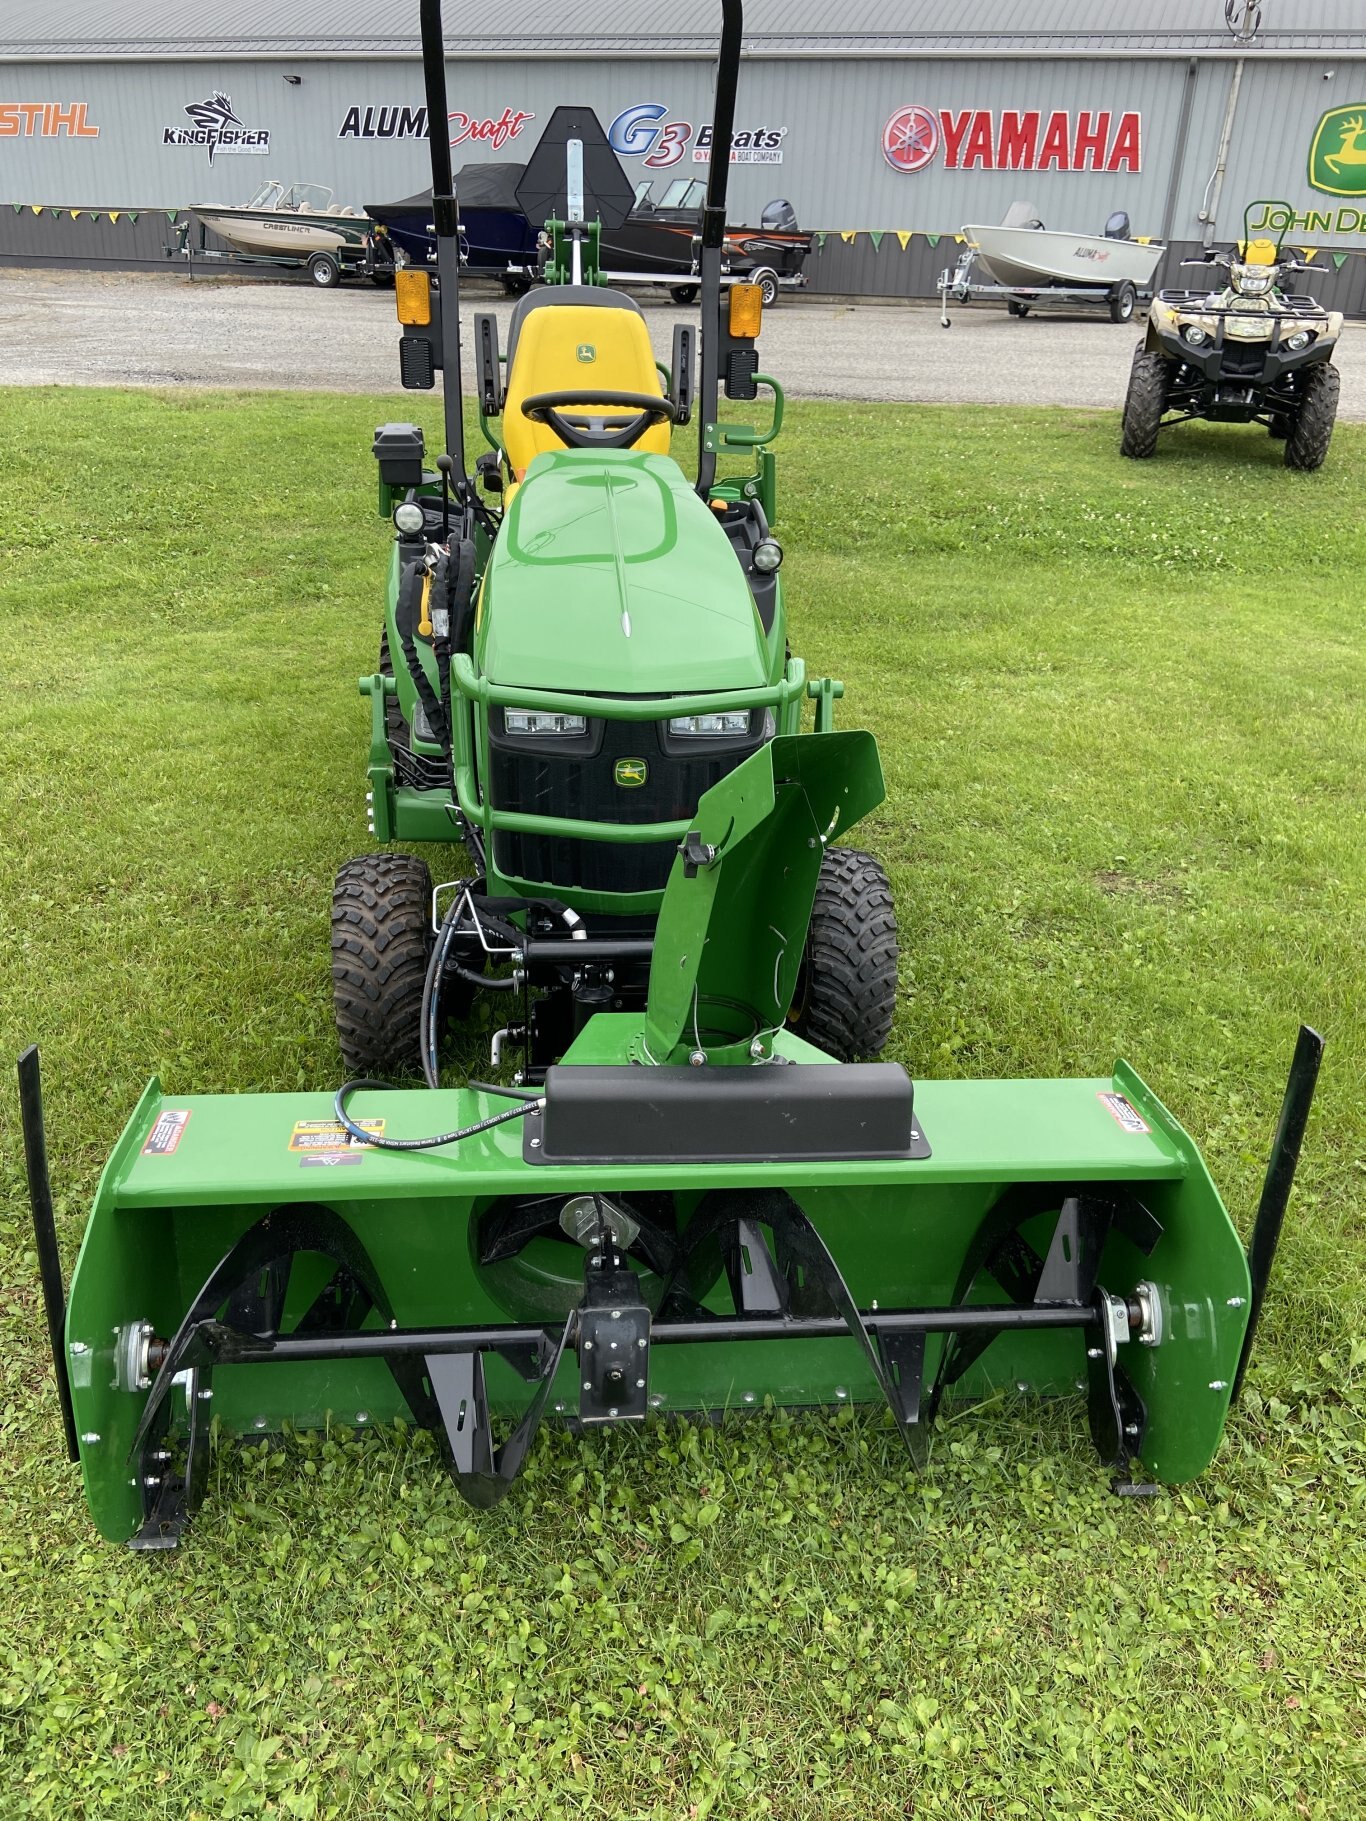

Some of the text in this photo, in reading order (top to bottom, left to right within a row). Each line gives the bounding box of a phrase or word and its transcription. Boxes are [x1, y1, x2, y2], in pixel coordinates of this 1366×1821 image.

[0, 103, 100, 137] STIHL
[163, 128, 270, 145] KINGFISHER
[610, 104, 692, 168] G3
[695, 124, 782, 150] Bats
[939, 110, 1142, 172] YAMAHA
[737, 151, 752, 162] BOAT
[753, 151, 781, 162] COMPANY
[263, 223, 311, 234] CRESTLINER
[1250, 204, 1366, 234] JOHN DE
